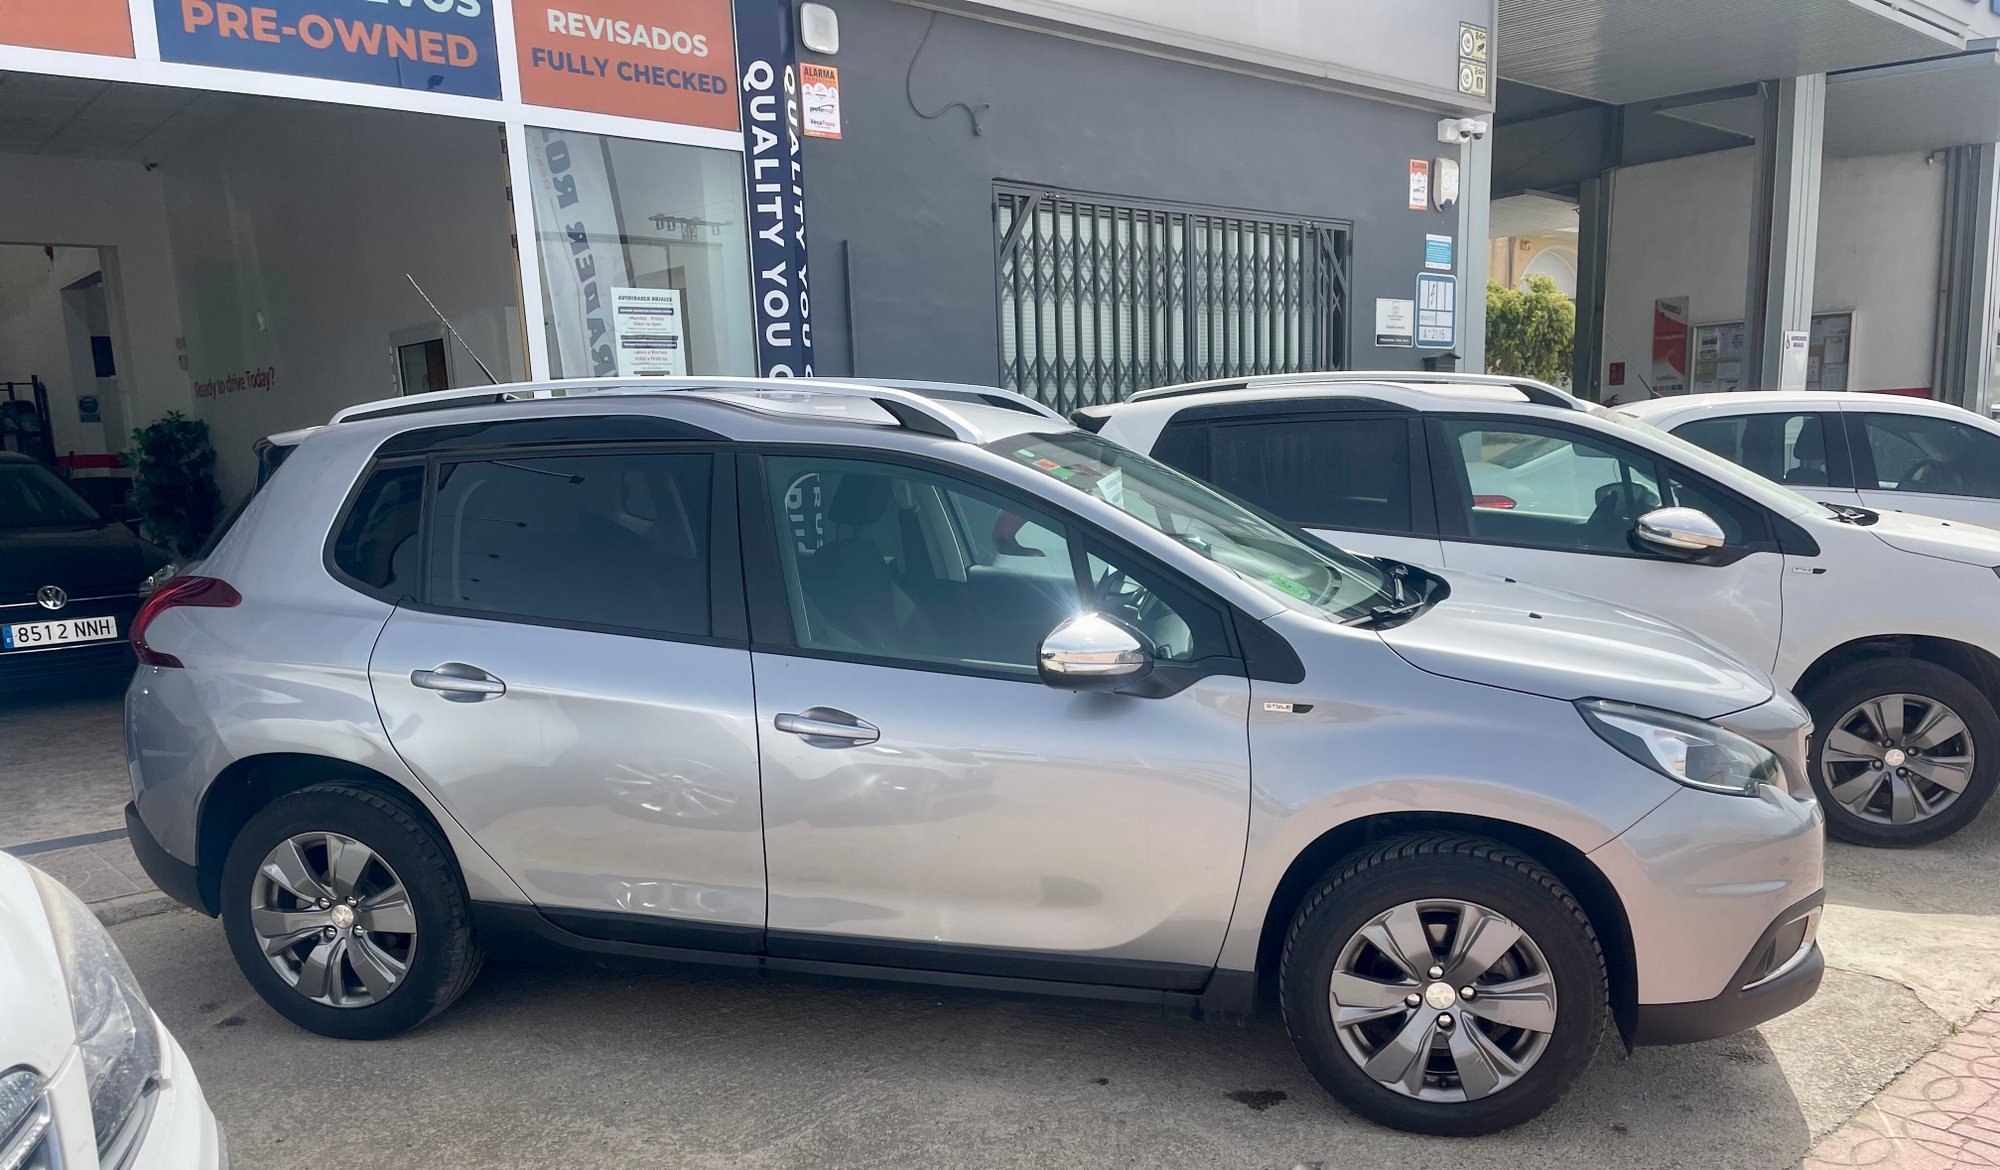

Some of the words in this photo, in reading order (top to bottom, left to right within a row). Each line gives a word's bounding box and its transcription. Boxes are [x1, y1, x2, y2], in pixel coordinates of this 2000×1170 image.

[181, 0, 478, 68] PRE-OWNED
[547, 9, 709, 58] REVISADOS
[531, 47, 610, 77] FULLY
[617, 61, 728, 95] CHECKED
[804, 66, 835, 80] ALARMA
[743, 60, 785, 247] QUALITY
[784, 65, 806, 250] QUALITY
[798, 264, 811, 347] YOU
[762, 261, 792, 346] YOU
[194, 378, 216, 400] Ready
[217, 379, 225, 394] to
[226, 373, 245, 392] drive
[245, 366, 275, 391] Today?
[18, 624, 68, 643] 8512
[74, 619, 111, 638] NNH
